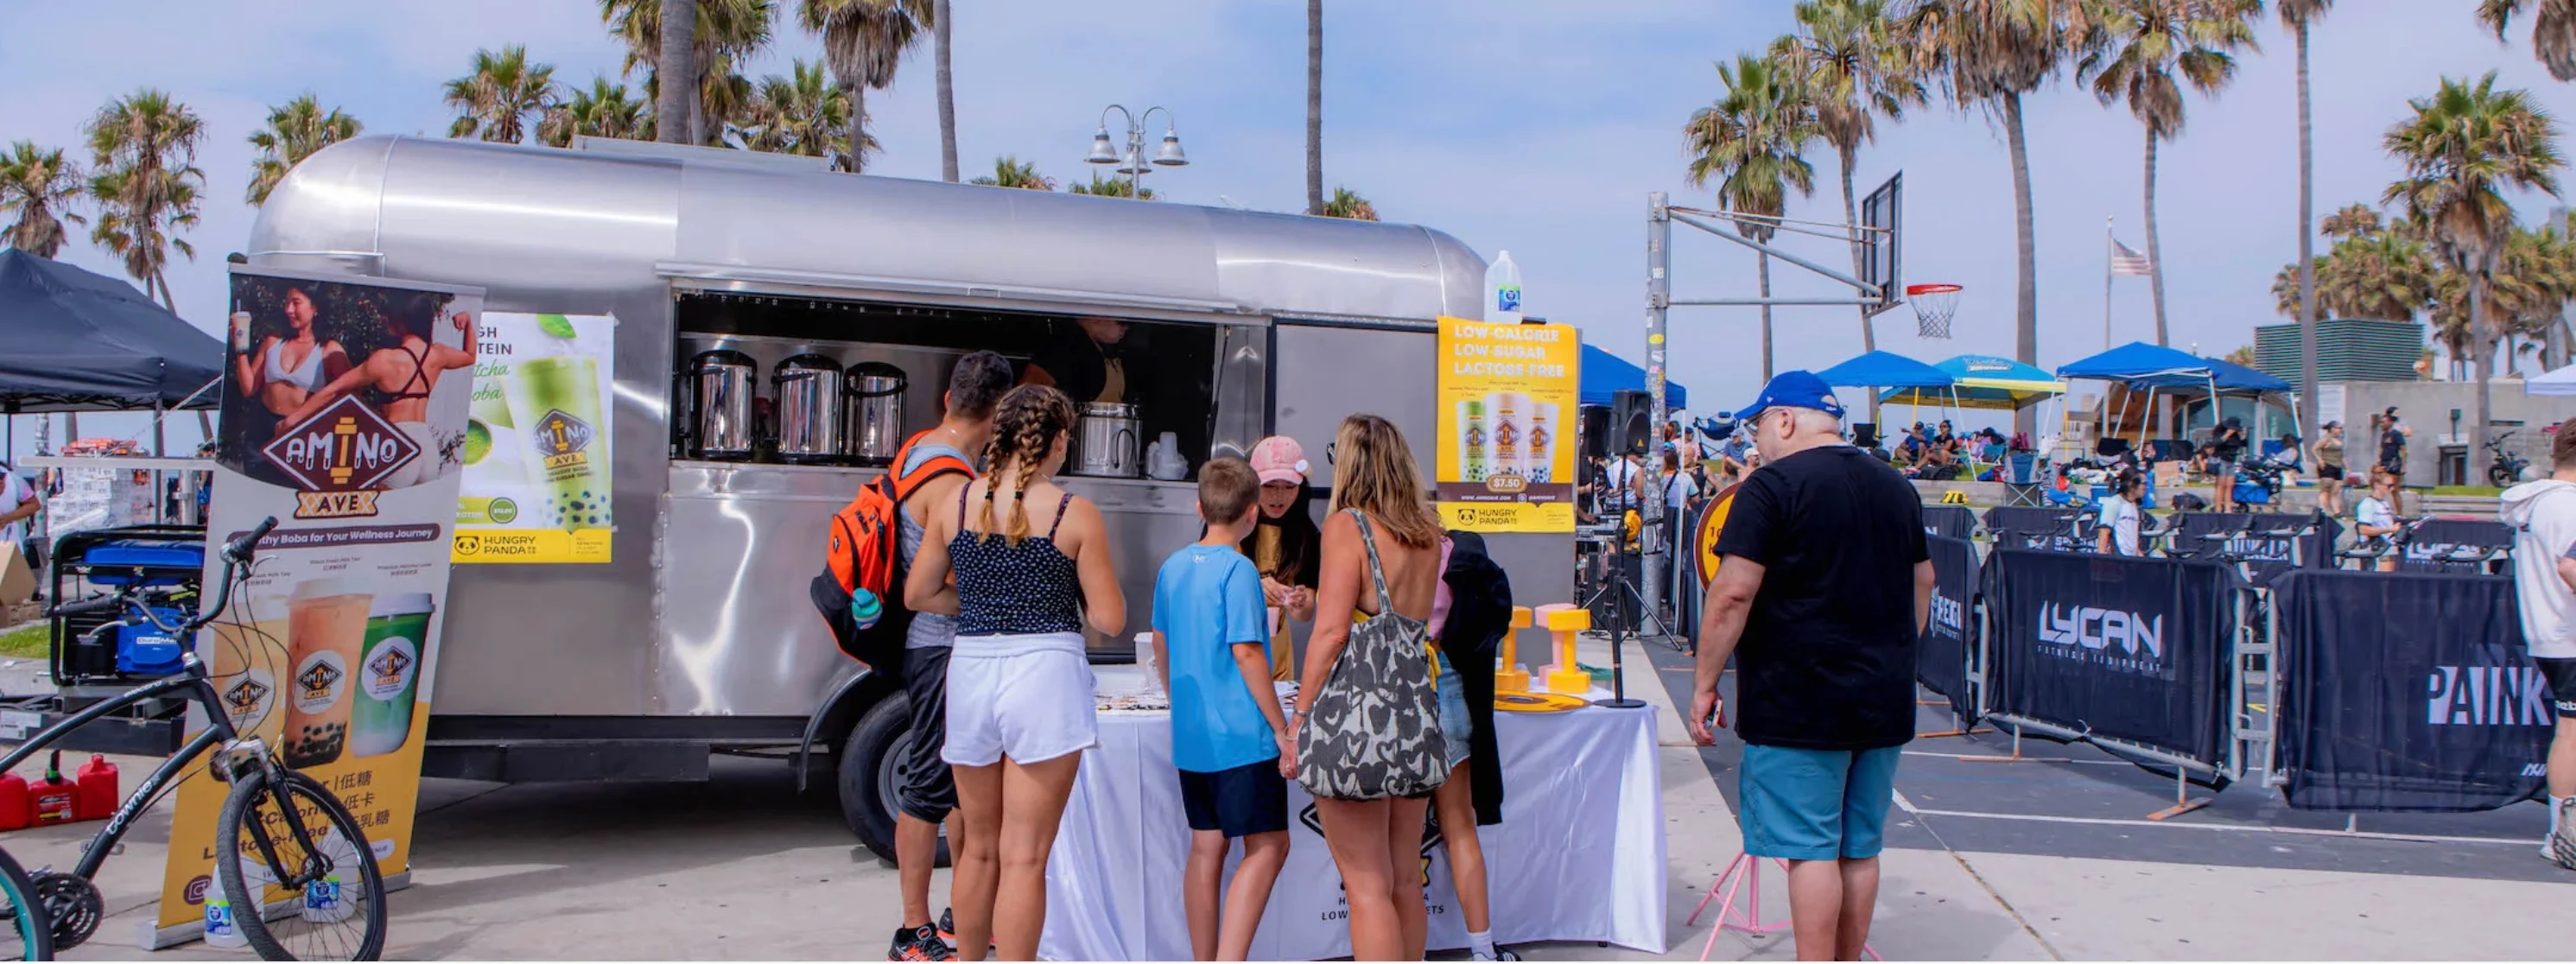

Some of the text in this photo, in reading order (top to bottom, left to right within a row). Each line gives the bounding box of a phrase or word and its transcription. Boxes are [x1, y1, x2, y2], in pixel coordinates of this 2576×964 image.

[478, 327, 497, 338] GH
[1454, 325, 1558, 342] LOW-CALORIE
[478, 343, 512, 355] TEIN
[1454, 344, 1545, 359] LOW-SUGAR
[474, 359, 511, 377] tcha
[1454, 363, 1565, 378] LACTOSE-FREE
[472, 384, 501, 401] oba
[286, 419, 397, 482] AMINO
[555, 453, 578, 464] AVE
[1494, 478, 1520, 488] $7.50
[317, 495, 358, 512] AVE
[281, 533, 308, 544] Boba
[310, 532, 325, 543] for
[327, 530, 348, 542] Your
[350, 529, 395, 541] Wellness
[396, 528, 433, 540] Journey
[484, 536, 536, 544] HUNGRY
[484, 545, 526, 555] PANDA
[2039, 599, 2162, 658] LYCAN
[2428, 666, 2552, 726] PAINK
[340, 770, 373, 790] 低糖
[106, 780, 153, 835] townie
